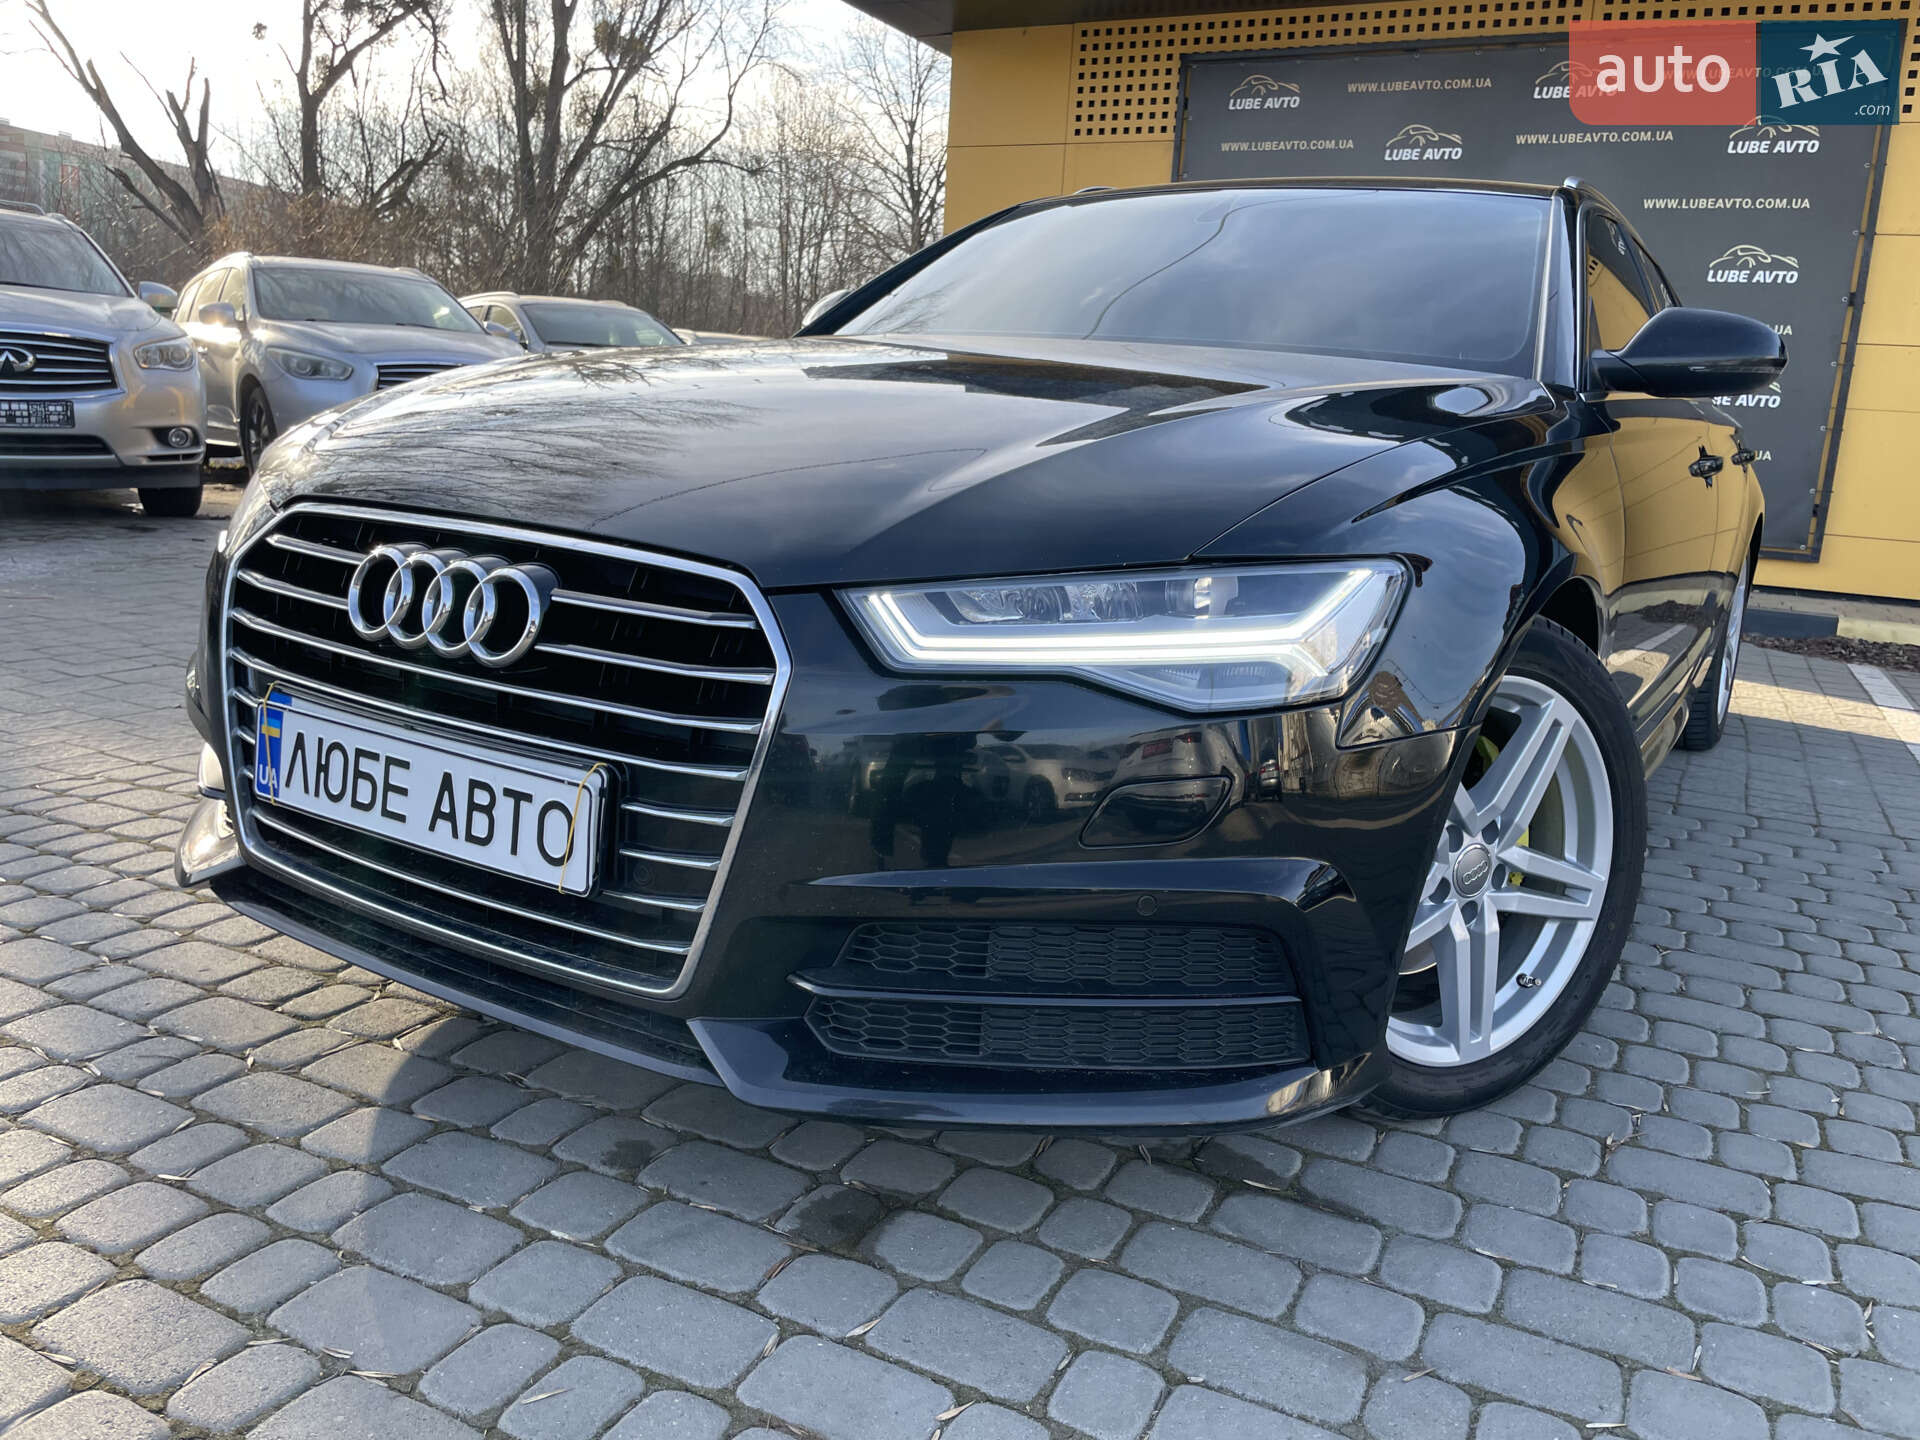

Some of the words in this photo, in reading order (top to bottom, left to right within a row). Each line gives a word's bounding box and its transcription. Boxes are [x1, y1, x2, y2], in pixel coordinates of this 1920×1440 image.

[1347, 78, 1492, 93] WWW.LUBEAVTO.COM.UA
[1533, 86, 1570, 99] LUBE
[1228, 97, 1263, 110] LUBE
[1264, 96, 1300, 109] AVTO
[1515, 130, 1674, 145] WWW.LUBEAVTO.COM.UA
[1220, 139, 1354, 152] WWW.LUBEAVTO.COM.UA
[1727, 140, 1769, 154] LUBE
[1773, 140, 1820, 154] AVTO
[1384, 148, 1420, 161] LUBE
[1423, 147, 1463, 160] AVTO
[1643, 198, 1811, 209] WWW.LUBEAVTO.COM.UA
[1706, 269, 1750, 283] LUBE
[1752, 270, 1799, 284] AVTO
[1735, 394, 1781, 408] AVTO
[285, 731, 411, 824] ЛЮБЕ
[428, 771, 575, 867] АВТО
